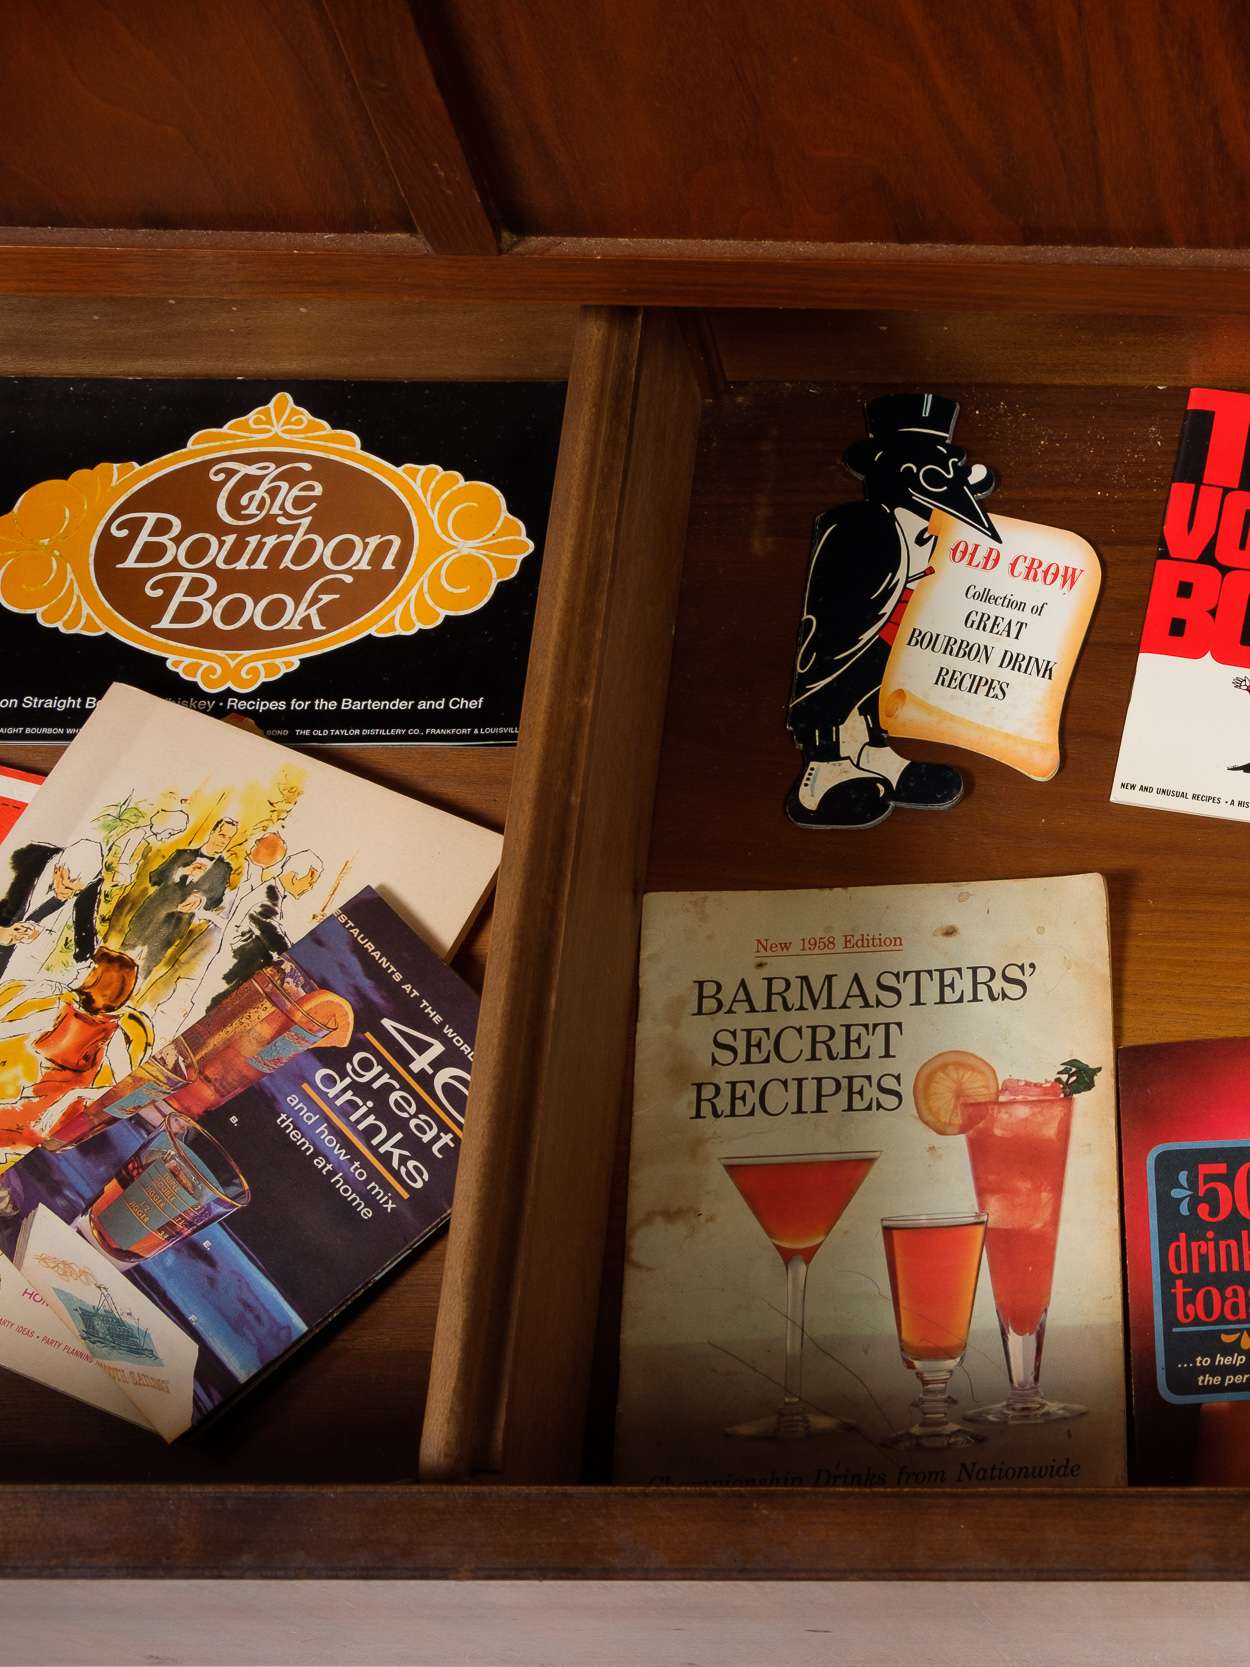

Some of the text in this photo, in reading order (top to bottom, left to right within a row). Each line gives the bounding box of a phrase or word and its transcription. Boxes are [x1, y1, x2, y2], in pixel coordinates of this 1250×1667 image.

[209, 462, 323, 526] The
[110, 512, 401, 571] Bourbon
[948, 539, 1085, 592] OLD CROW
[145, 572, 353, 631] Book
[965, 584, 1048, 617] Collection of
[964, 609, 1028, 641] GREAT
[905, 627, 1058, 681] BOURBON DRINK
[22, 696, 82, 711] Straight
[165, 697, 216, 712] iskey
[226, 698, 286, 712] Recipes
[290, 697, 311, 710] for
[314, 698, 337, 710] the
[341, 698, 415, 710] Bartender
[417, 697, 446, 710] and
[449, 697, 484, 710] Chef
[933, 666, 1010, 701] RECIPES
[362, 728, 406, 736] DISTILLERY
[1120, 782, 1137, 791] NEW
[1138, 784, 1154, 793] AND
[1156, 787, 1189, 800] UNUSUAL
[1191, 793, 1222, 805] RECIPES
[1229, 799, 1235, 807] A
[755, 933, 904, 954] New 1958 Edition
[333, 909, 475, 1062] ESTAURANTS AT THE WORL
[710, 1021, 904, 1067] SECRET
[346, 1051, 455, 1159] great
[689, 1073, 904, 1120] RECIPES
[314, 1068, 429, 1189] drinks
[275, 1112, 374, 1220] them at home
[286, 1093, 397, 1214] and how to mix
[129, 1200, 150, 1224] JIGGER
[145, 1185, 166, 1209] JIGGER
[0, 1317, 94, 1364] ARTY IDEAS PARTY PLANNING
[1214, 1353, 1246, 1367] help
[1197, 1374, 1221, 1386] the
[813, 1466, 887, 1487] Drinks
[896, 1465, 948, 1487] from
[956, 1457, 1081, 1482] Nationwide
